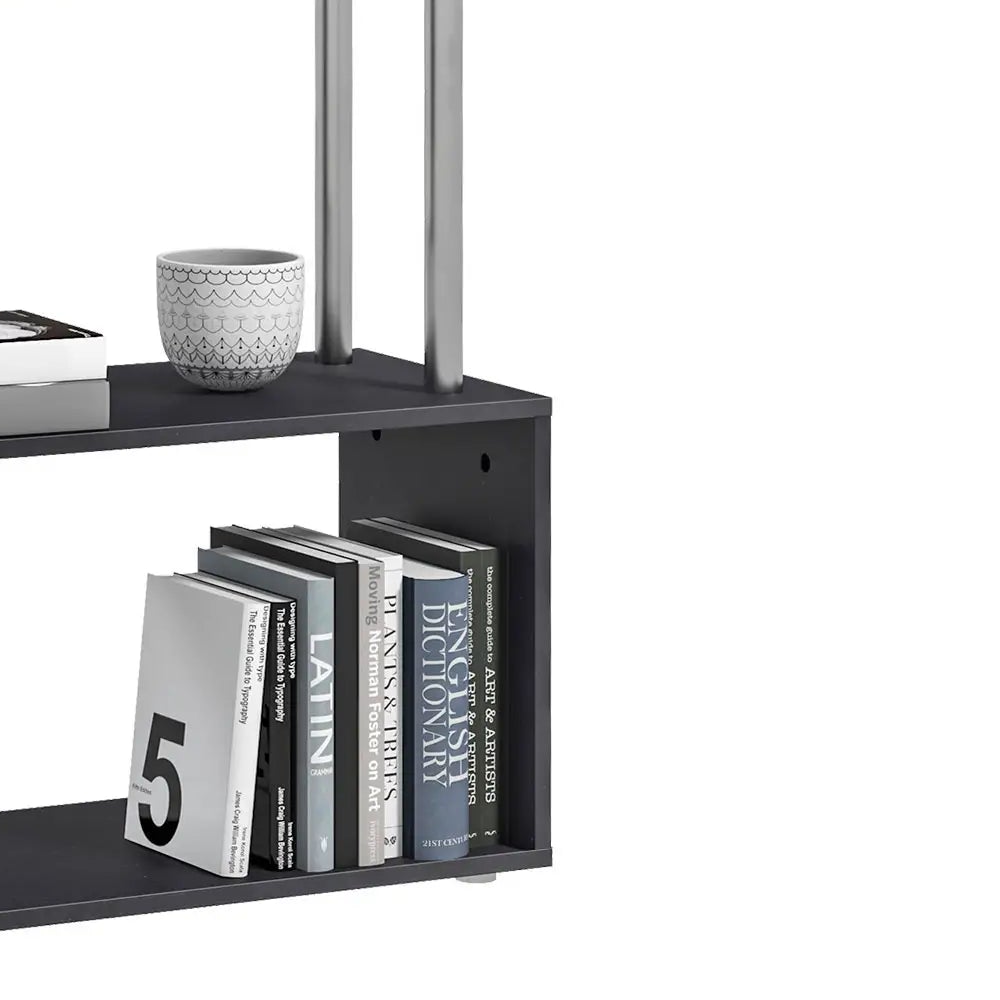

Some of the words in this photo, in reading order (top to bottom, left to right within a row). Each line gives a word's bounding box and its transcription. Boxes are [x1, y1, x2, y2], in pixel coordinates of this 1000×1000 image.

[486, 566, 494, 582] the
[365, 566, 381, 626] Moving
[485, 583, 494, 625] complete
[249, 610, 258, 623] The
[259, 605, 270, 645] Designing
[276, 608, 286, 621] The
[288, 602, 297, 642] Designing
[246, 624, 257, 654] Essential
[276, 622, 286, 653] Essential
[485, 626, 494, 652] guide
[244, 656, 254, 676] Guide
[276, 654, 286, 674] Guide
[288, 661, 296, 679] type
[368, 630, 382, 698] Norman
[486, 653, 494, 663] to
[256, 665, 264, 683] type
[276, 674, 285, 682] to
[485, 667, 496, 704] ART
[274, 683, 286, 722] Typography
[309, 632, 334, 766] LATIN
[421, 602, 448, 788] DICTIONARY
[447, 602, 469, 788] ENGLISH
[468, 671, 476, 706] ART
[238, 685, 252, 725] Typography
[468, 711, 476, 726] &
[485, 708, 497, 724] &
[368, 702, 381, 756] Foster
[368, 760, 379, 780] on
[384, 719, 397, 801] TREES
[468, 731, 476, 805] ARTISTS
[485, 727, 497, 803] ARTISTS
[138, 712, 187, 848] 5
[234, 790, 242, 808] James
[277, 787, 285, 805] James
[368, 785, 381, 812] Art
[232, 809, 241, 824] Craig
[276, 805, 285, 820] Craig
[231, 824, 239, 845] William
[277, 821, 285, 841] William
[229, 846, 238, 874] Bevington
[276, 842, 285, 870] Bevington
